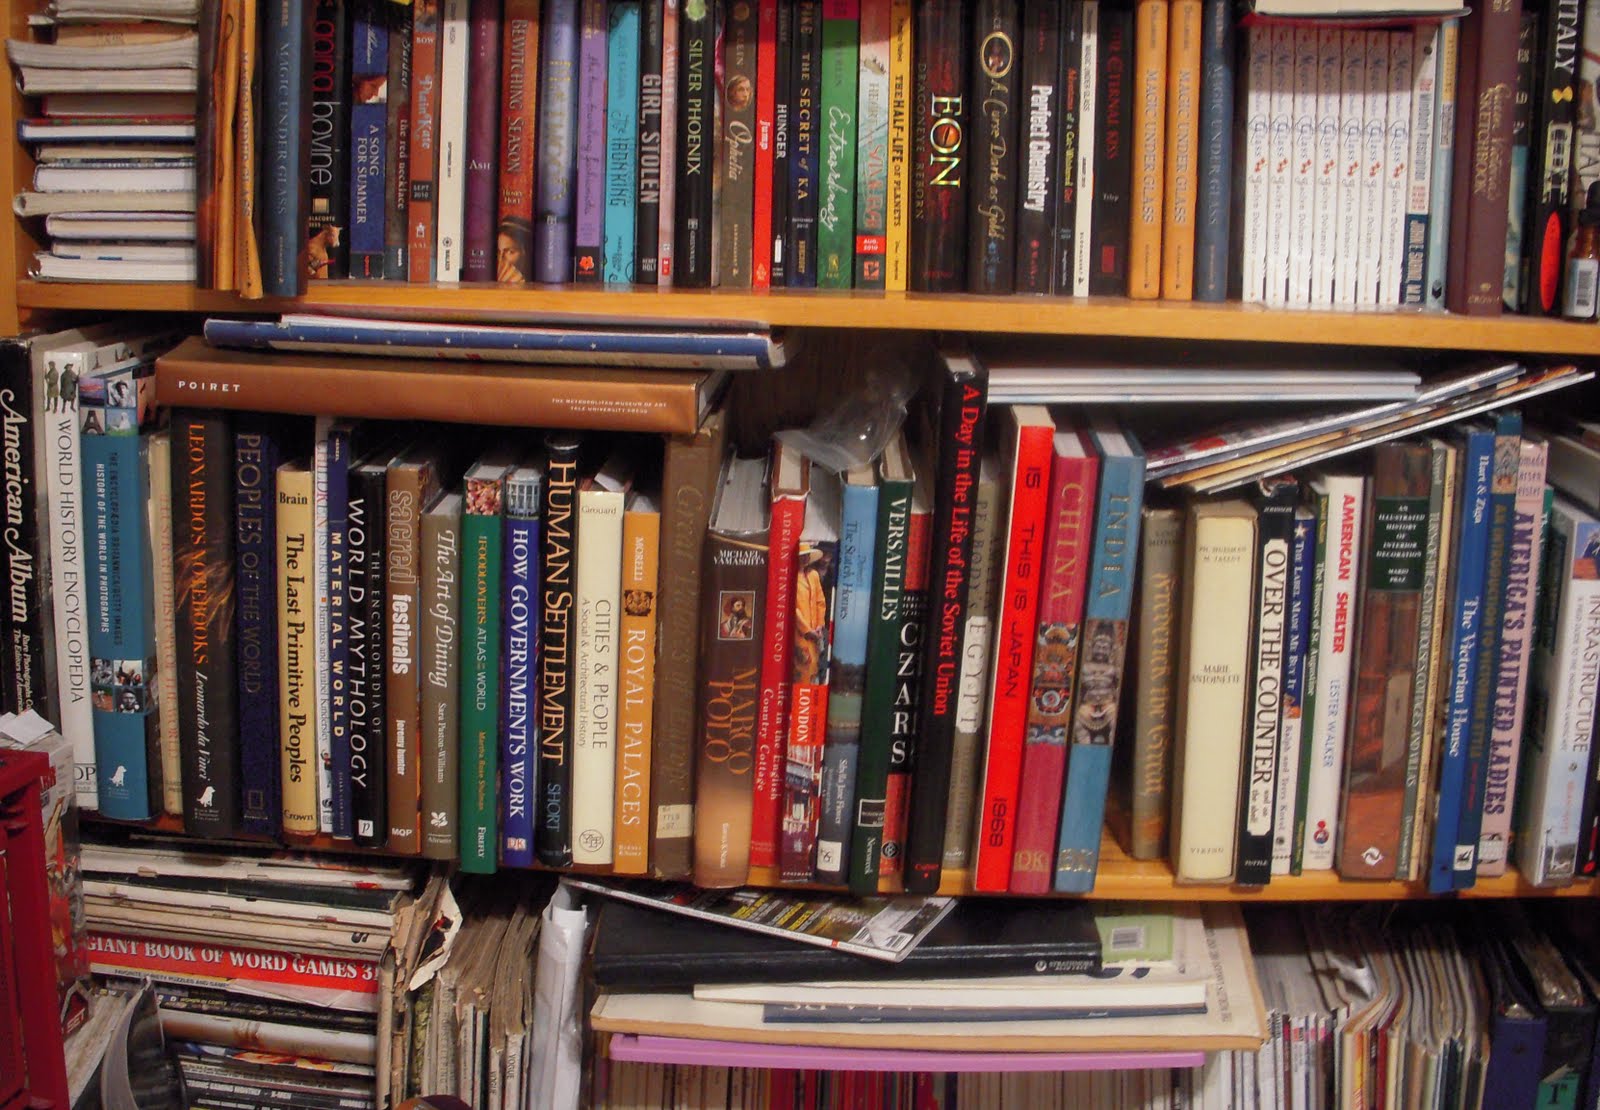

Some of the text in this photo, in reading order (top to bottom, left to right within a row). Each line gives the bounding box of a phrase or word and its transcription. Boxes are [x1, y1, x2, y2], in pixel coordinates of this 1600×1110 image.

[801, 52, 812, 82] THE
[1555, 0, 1580, 74] ITALY
[312, 101, 341, 185] bovine
[368, 124, 380, 177] A SONG
[507, 19, 528, 174] BEWITCHING SEASON
[639, 74, 661, 204] GIRL, STOLEN
[686, 39, 704, 176] SILVER PHOENIX
[727, 120, 753, 181] Ophelia
[775, 103, 788, 160] HUNGER
[798, 88, 812, 155] SECRET
[928, 93, 964, 189] EON
[1023, 84, 1053, 213] Perfect Chemistry
[1141, 69, 1159, 225] MAGIC UNDER GLASS
[1174, 69, 1192, 225] MAGIC UNDER GLASS
[1473, 89, 1494, 195] SKETCHBOOK
[356, 137, 368, 225] FOR SUMMER
[797, 176, 809, 201] KA
[819, 105, 852, 233] Extraordinary
[178, 380, 242, 394] POIRET
[0, 388, 35, 623] American Album
[97, 463, 110, 633] HISTORY OF THE WORLD IN PHOTOGRAPHS
[188, 424, 210, 664] LEONARDO'S NOTEBOOKS
[279, 491, 308, 506] Brain
[389, 489, 417, 585] sacred
[933, 384, 983, 717] A Day in the Life of the Soviet Union
[1046, 482, 1085, 602] CHINA
[1098, 493, 1132, 600] INDIA
[58, 420, 85, 704] WORLD HISTORY ENCYCLOPEDIA
[236, 433, 262, 694] PEOPLES OF THE WORLD
[718, 548, 761, 559] MICHAEL
[774, 510, 793, 664] ADRIAN TINNISWOOD
[880, 496, 908, 622] VERSAILLES
[1331, 493, 1356, 655] AMERICAN SHELTER
[1503, 512, 1536, 631] AMERICA'S
[14, 645, 23, 671] Editors
[286, 533, 307, 784] The Last Primitive Peoples
[331, 531, 345, 737] MATERIAL WORLD
[347, 499, 367, 789] WORLD MYTHOLOGY
[371, 549, 382, 736] THE ENCYCLOPEDIA OF
[391, 593, 413, 676] festivals
[428, 529, 457, 689] The Art of Dining
[476, 626, 487, 662] ATLAS
[541, 459, 578, 766] HUMAN SETTLEMENT
[1004, 522, 1036, 700] THIS IS JAPAN
[22, 654, 33, 698] Photographs
[476, 670, 487, 711] WORLD
[508, 528, 530, 820] HOW GOVERNMENTS WORK
[591, 599, 612, 750] CITIES & PEOPLE
[624, 628, 647, 712] ROYAL
[704, 680, 735, 763] POLO
[726, 666, 758, 777] MARCO
[796, 687, 812, 743] LONDON
[889, 621, 920, 766] CZARS
[1252, 548, 1287, 786] OVER THE COUNTER
[1447, 595, 1480, 758] The Victorian House
[1492, 637, 1523, 733] PAINTED
[1572, 595, 1600, 753] INFRASTRUCTURE
[195, 671, 212, 780] Leonardo da Vinci
[621, 720, 644, 827] PALACES
[1322, 679, 1341, 769] LESTER WALKER
[1484, 738, 1513, 816] LADIES
[476, 827, 487, 859] FIREFLY
[546, 783, 561, 833] SHORT
[86, 935, 139, 957] GIANT
[145, 942, 194, 963] BOOK
[200, 946, 223, 964] OF
[228, 952, 289, 973] WORD
[292, 957, 358, 979] GAMES
[508, 1053, 518, 1080] VOGUE
